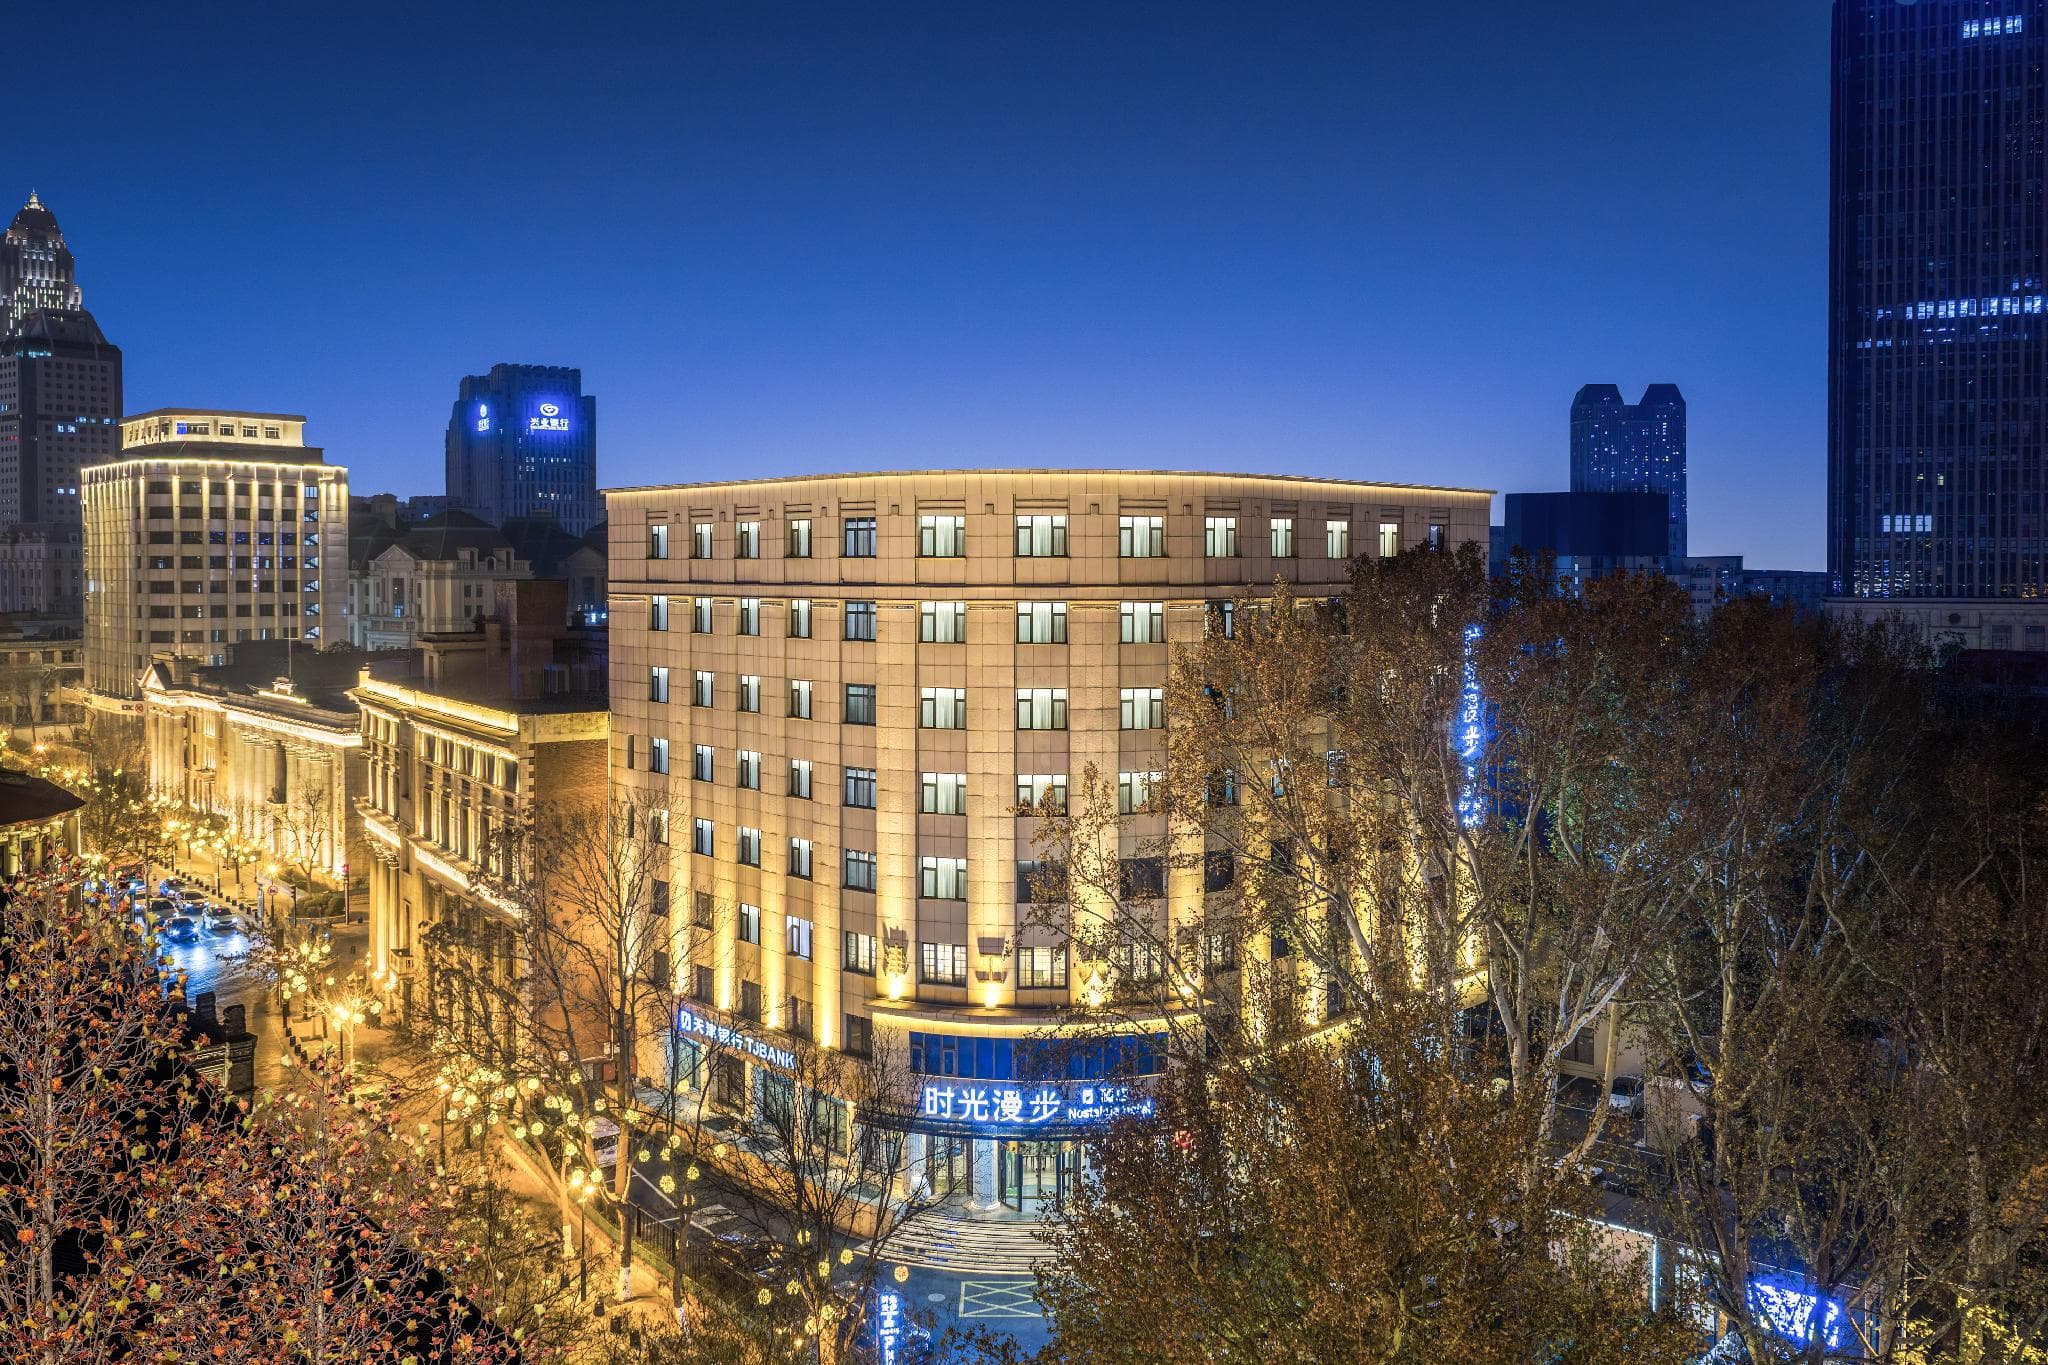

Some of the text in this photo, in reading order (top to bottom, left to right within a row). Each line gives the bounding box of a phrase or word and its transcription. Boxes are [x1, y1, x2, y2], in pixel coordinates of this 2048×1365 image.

[530, 417, 569, 427] 兴业银行
[693, 1016, 795, 1070] 天津银行 TJBANK
[925, 1086, 1061, 1123] 时光漫步
